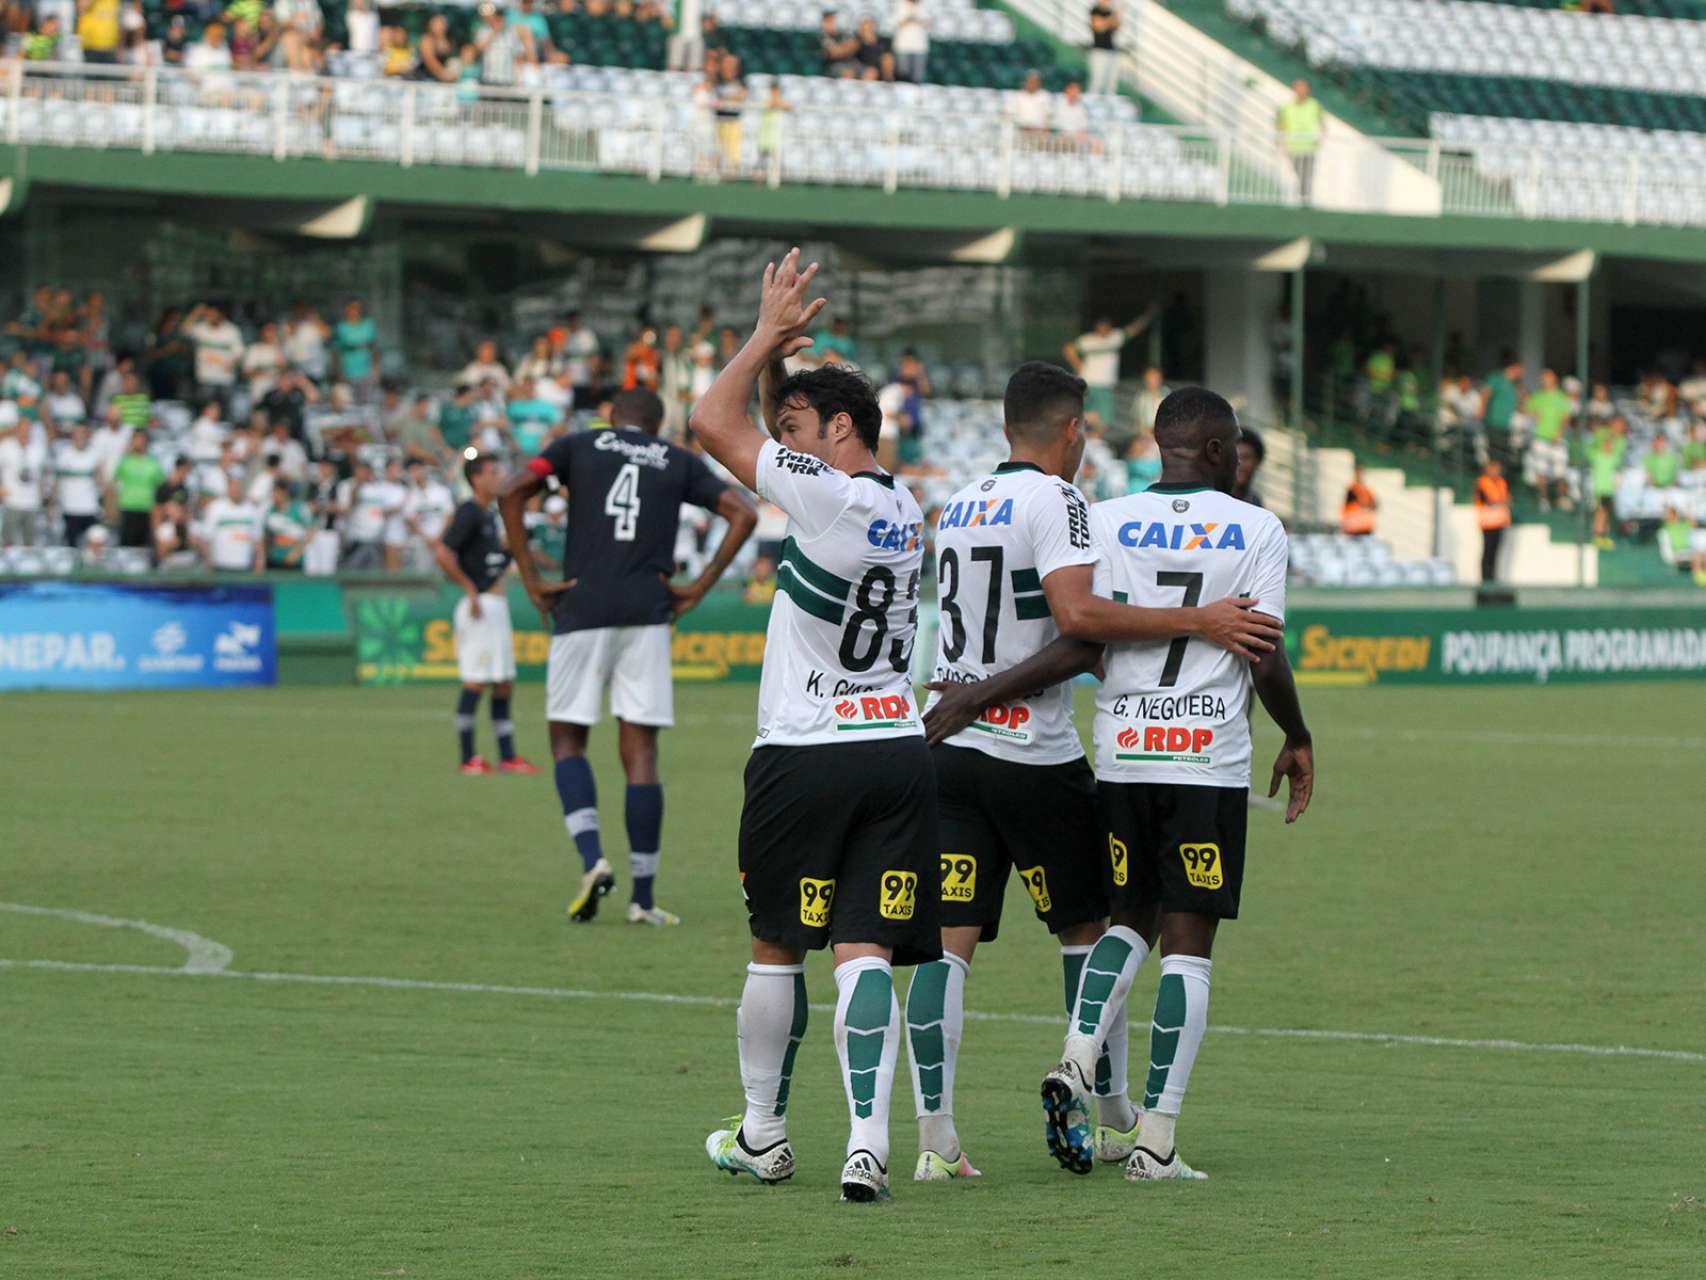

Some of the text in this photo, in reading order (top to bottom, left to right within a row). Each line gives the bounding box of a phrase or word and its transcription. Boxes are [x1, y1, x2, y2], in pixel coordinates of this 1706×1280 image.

[605, 463, 641, 541] 4
[939, 498, 1014, 530] CAIXA
[867, 519, 923, 551] CAIX
[1117, 521, 1246, 550] CAIXA
[939, 546, 1003, 664] 37
[1156, 571, 1203, 687] 7
[806, 670, 824, 698] K.
[1113, 694, 1226, 720] G. NEGUEBA
[1143, 726, 1213, 753] RDP
[1183, 847, 1216, 872] 99
[803, 881, 834, 909] 99
[885, 875, 914, 901] 99
[942, 886, 972, 898] AXIS
[884, 904, 912, 915] TAXIS
